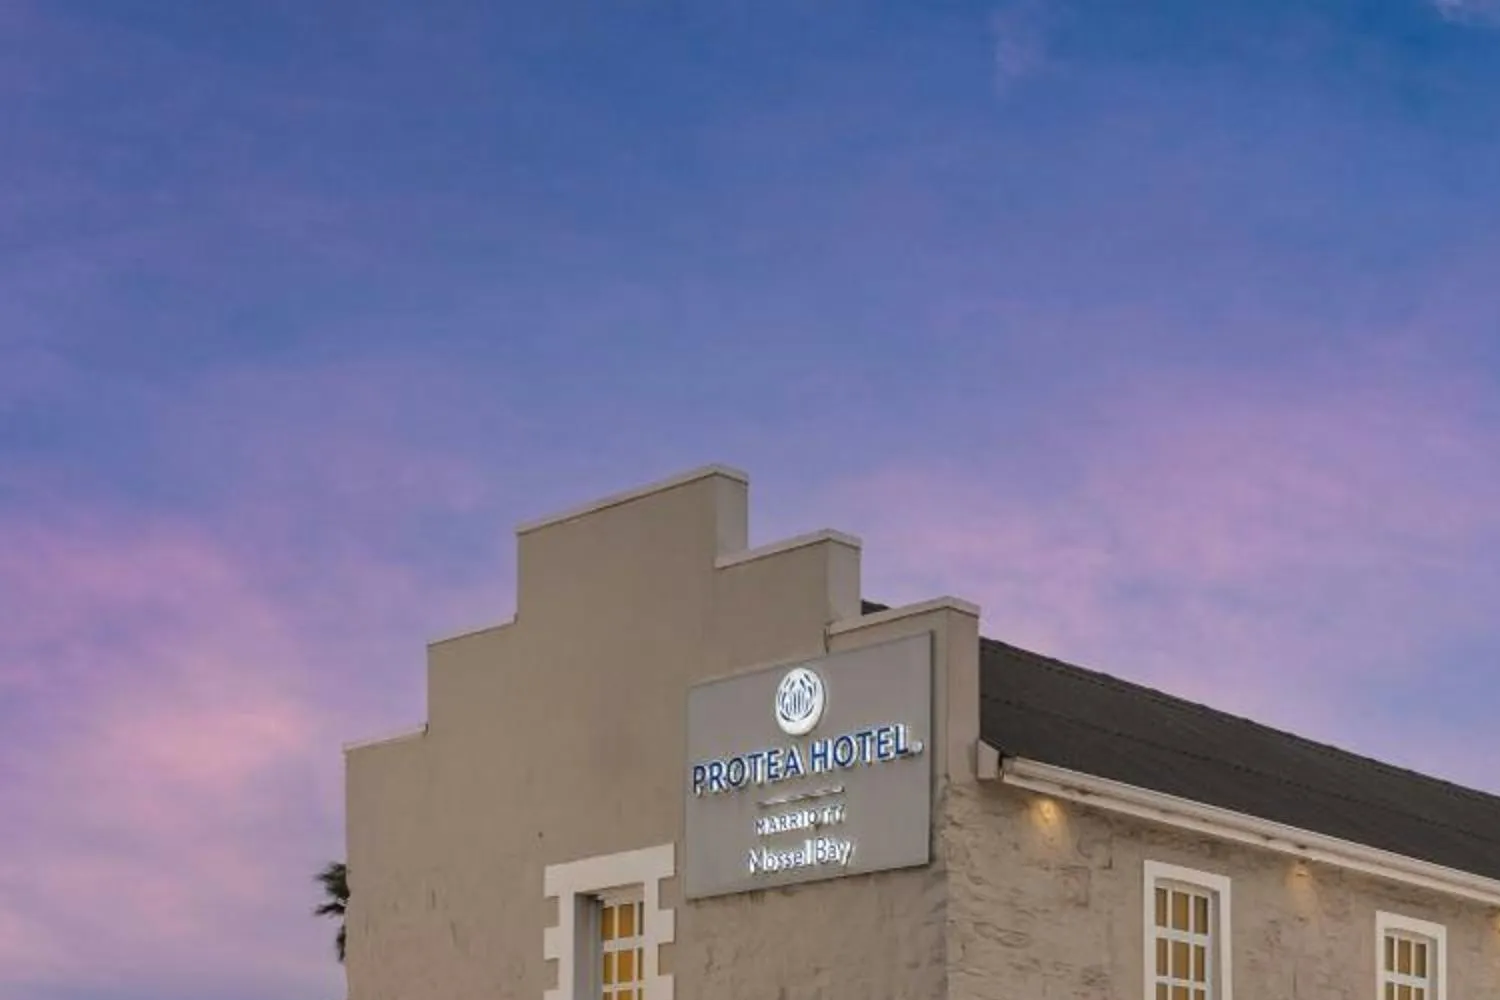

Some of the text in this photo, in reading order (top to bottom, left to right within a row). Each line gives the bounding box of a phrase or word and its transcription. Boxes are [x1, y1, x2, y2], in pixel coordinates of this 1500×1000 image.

[692, 723, 912, 797] PROTEA HOTEL
[814, 835, 855, 867] Bay
